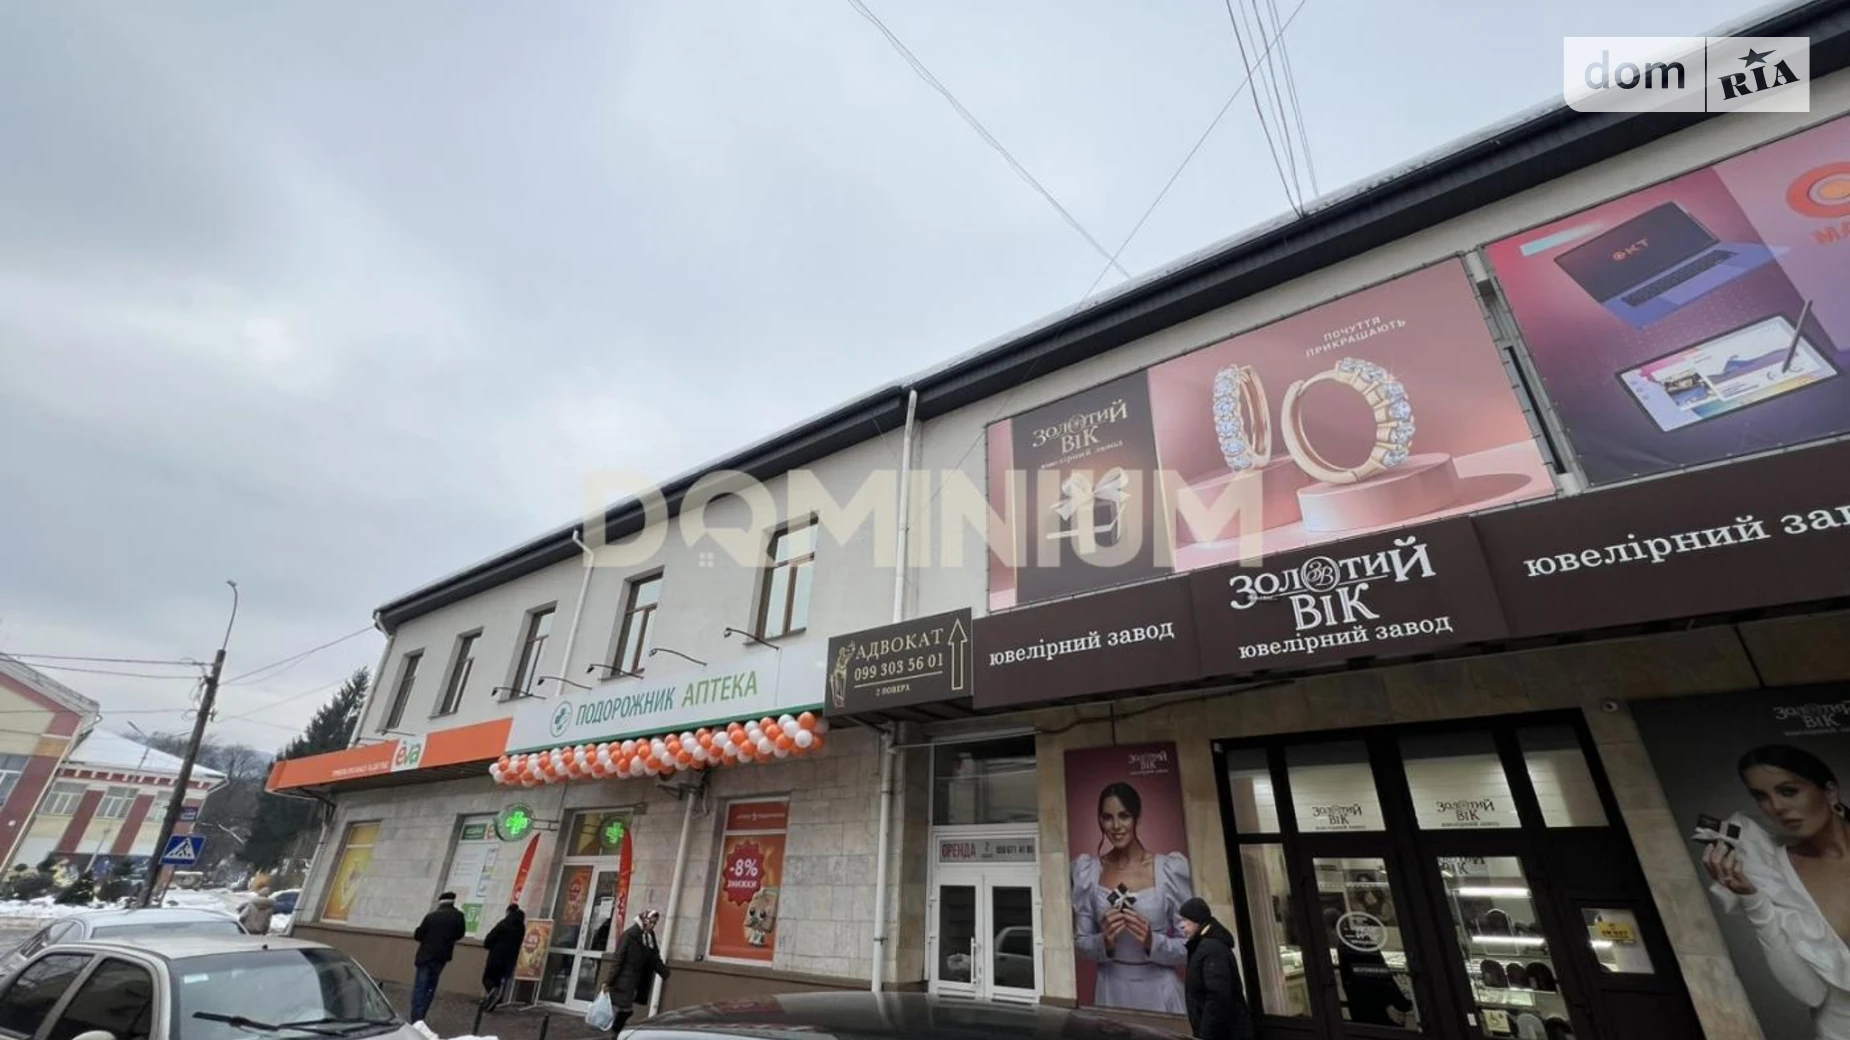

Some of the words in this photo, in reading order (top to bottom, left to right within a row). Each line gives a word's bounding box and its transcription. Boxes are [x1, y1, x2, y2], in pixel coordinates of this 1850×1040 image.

[1305, 319, 1406, 358] ПРИКРАШАЮТЬ
[1323, 316, 1381, 342] ПОЧУТТЯ
[1061, 425, 1100, 454] ВІК
[1523, 515, 1771, 578] ювелірний
[1289, 582, 1380, 631] ВІК
[856, 628, 944, 661] АДВОКАТ
[989, 631, 1101, 667] ювелірний
[1107, 621, 1175, 647] завод
[1238, 625, 1370, 659] ювелірний
[1375, 616, 1454, 640] завод
[854, 665, 877, 681] 099
[881, 660, 904, 677] 303
[908, 656, 924, 672] 56
[928, 652, 944, 668] 01
[575, 687, 676, 726] ПОДОРОЖНИК
[681, 670, 758, 708] АПТЕКА
[729, 859, 758, 877] -8%
[941, 842, 976, 858] ОРЕНДА
